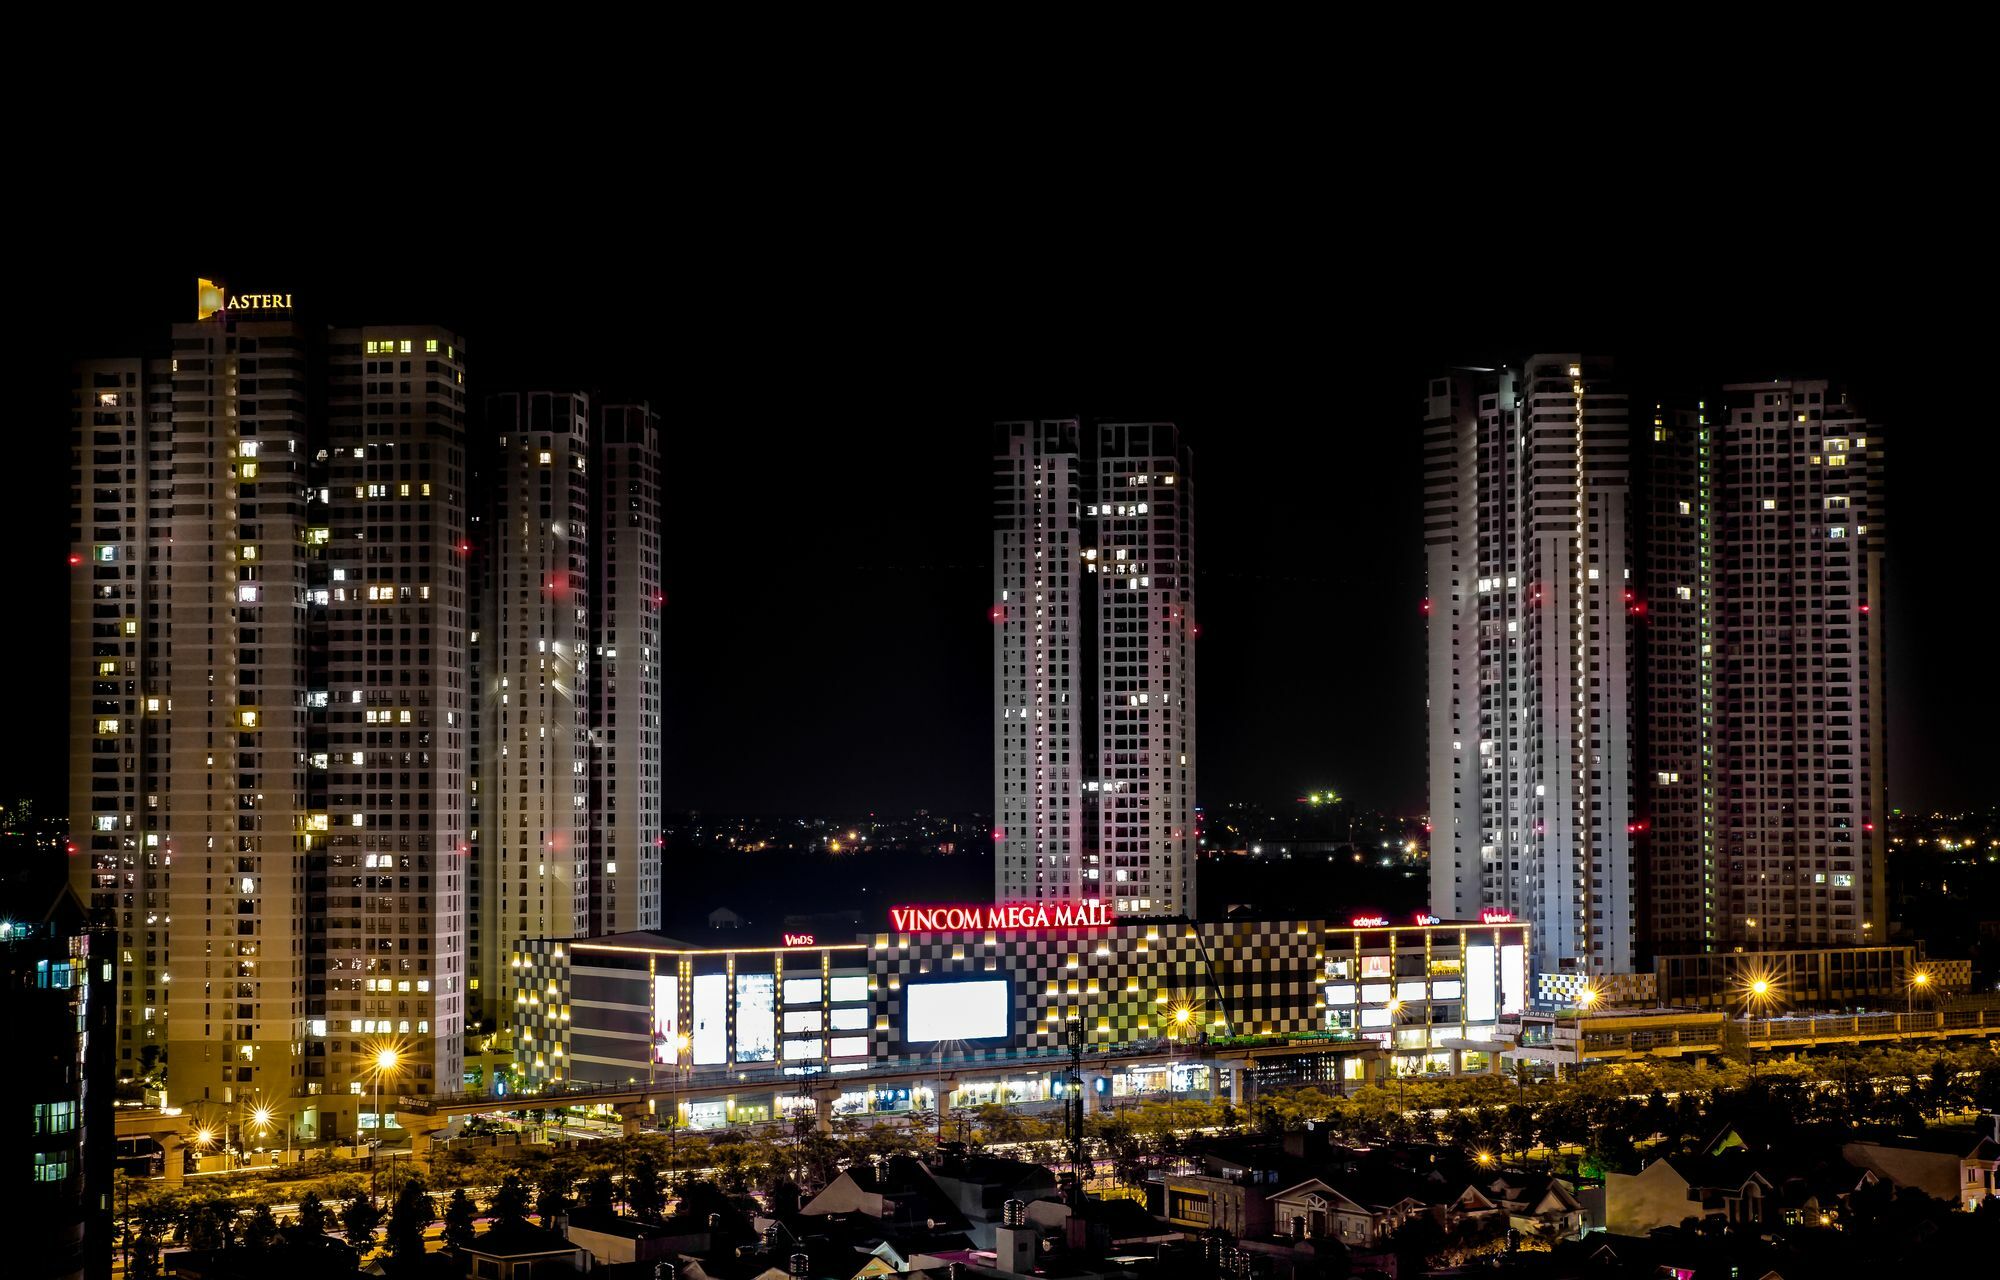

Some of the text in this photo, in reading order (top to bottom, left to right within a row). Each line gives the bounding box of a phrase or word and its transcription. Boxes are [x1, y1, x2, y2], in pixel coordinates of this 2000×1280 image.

[227, 294, 292, 309] ASTERI
[892, 905, 1111, 931] VINCOM MEGA MALL
[784, 934, 814, 946] VinDS
